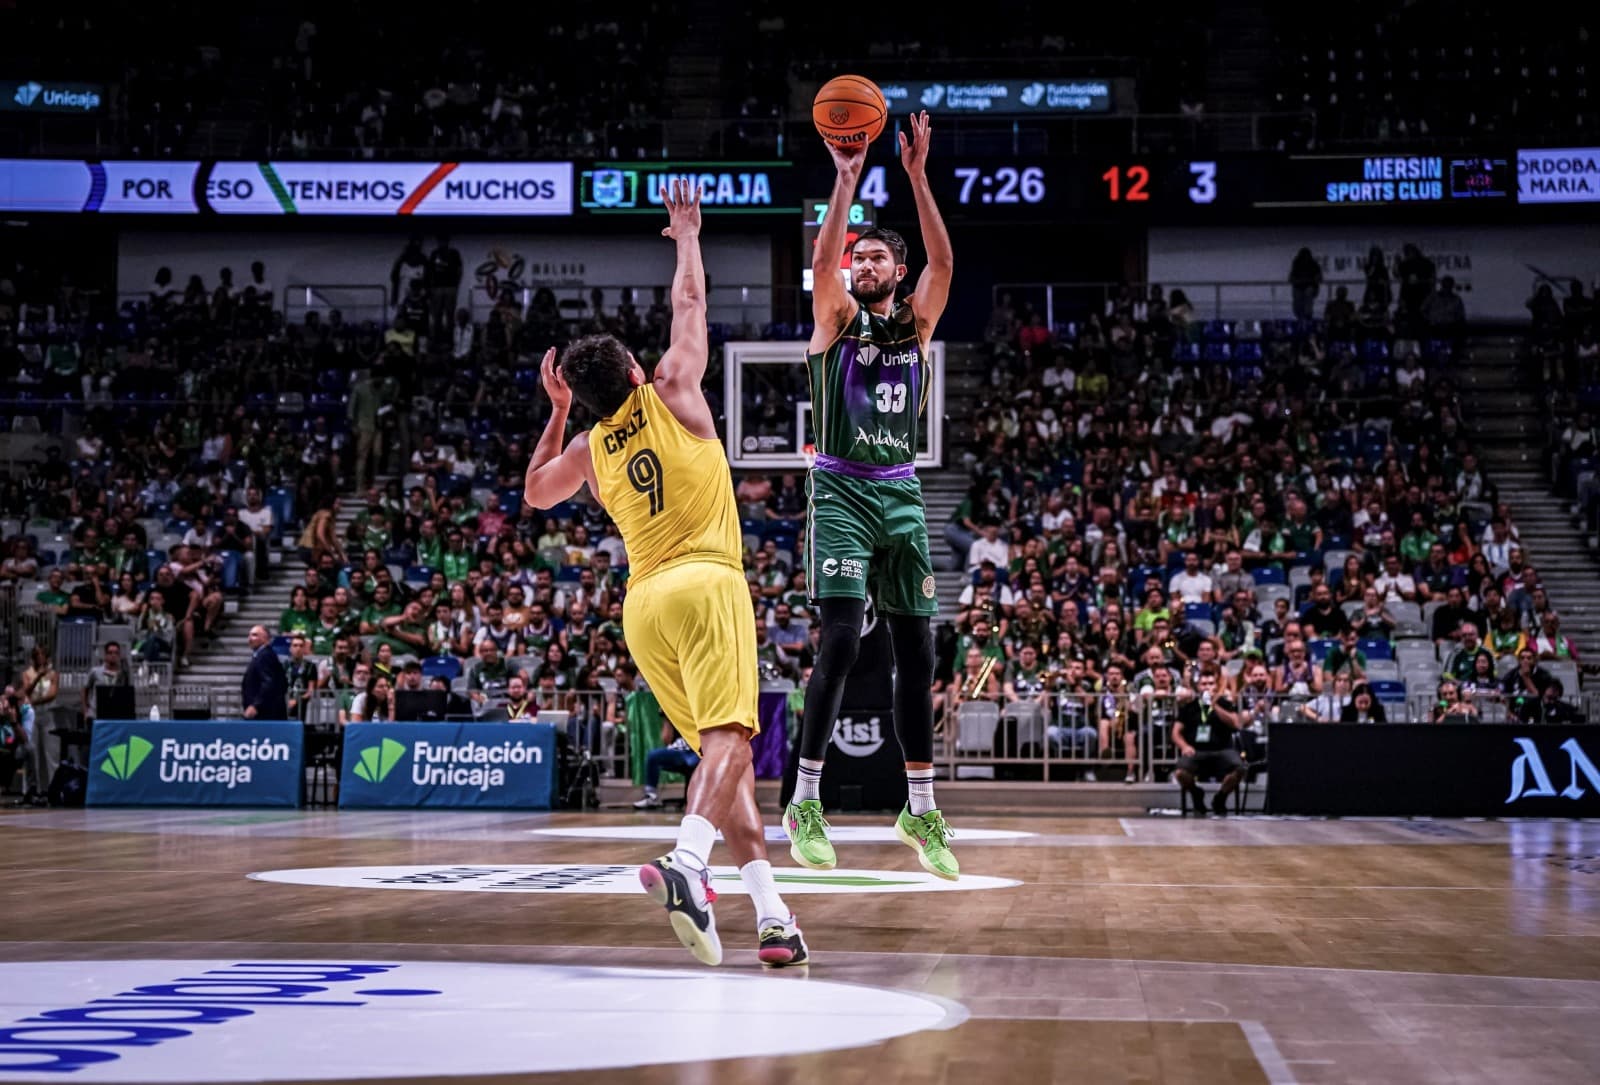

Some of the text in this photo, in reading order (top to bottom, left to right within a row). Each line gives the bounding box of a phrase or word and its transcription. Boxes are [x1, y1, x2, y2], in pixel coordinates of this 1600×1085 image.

[43, 90, 100, 110] Unicaja
[1102, 165, 1150, 201] 12
[1188, 161, 1217, 204] 3
[1364, 157, 1443, 180] MERSIN
[122, 179, 173, 199] POR
[286, 179, 405, 200] TENEMOS
[445, 179, 556, 200] MUCHOS
[647, 173, 772, 205] UNICAJA
[859, 166, 889, 208] 4
[954, 168, 1046, 203] 7:26
[1326, 180, 1443, 203] SPORTS CLUB
[875, 382, 907, 414] 33
[603, 407, 648, 456] CRUZ
[627, 448, 665, 518] 9
[161, 737, 290, 761] Fundación
[413, 740, 543, 764] Fundación
[159, 761, 253, 789] Unicaja
[412, 763, 505, 792] Unicaja
